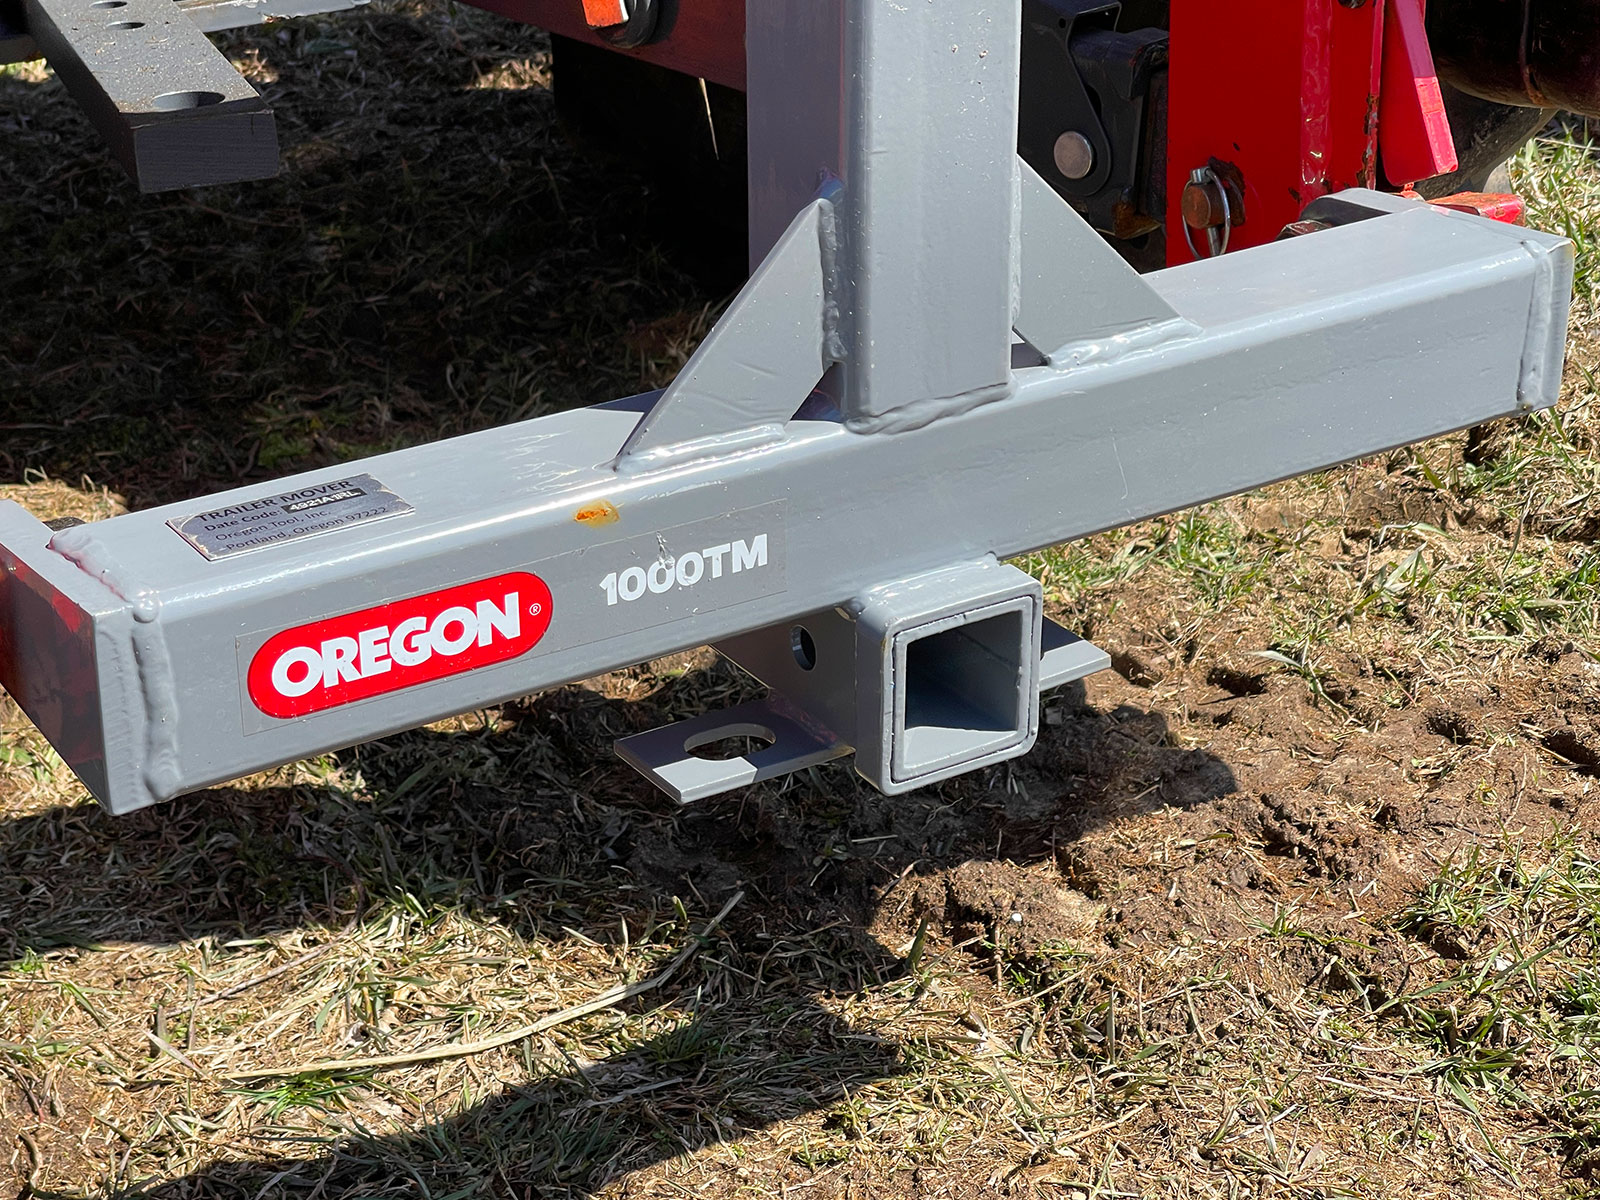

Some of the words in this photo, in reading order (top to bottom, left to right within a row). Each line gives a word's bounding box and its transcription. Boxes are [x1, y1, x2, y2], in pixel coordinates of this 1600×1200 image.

[195, 499, 278, 522] TRAILER
[280, 480, 354, 502] MOVER
[204, 519, 240, 531] Date
[241, 509, 283, 523] Code:
[215, 525, 268, 541] Oregon
[269, 516, 304, 529] Tool,
[305, 510, 331, 520] Inc.
[226, 531, 291, 550] Portland,
[292, 518, 345, 534] Oregon
[345, 506, 389, 521] 97222
[599, 533, 768, 606] 1000TM
[271, 591, 521, 698] OREGON
